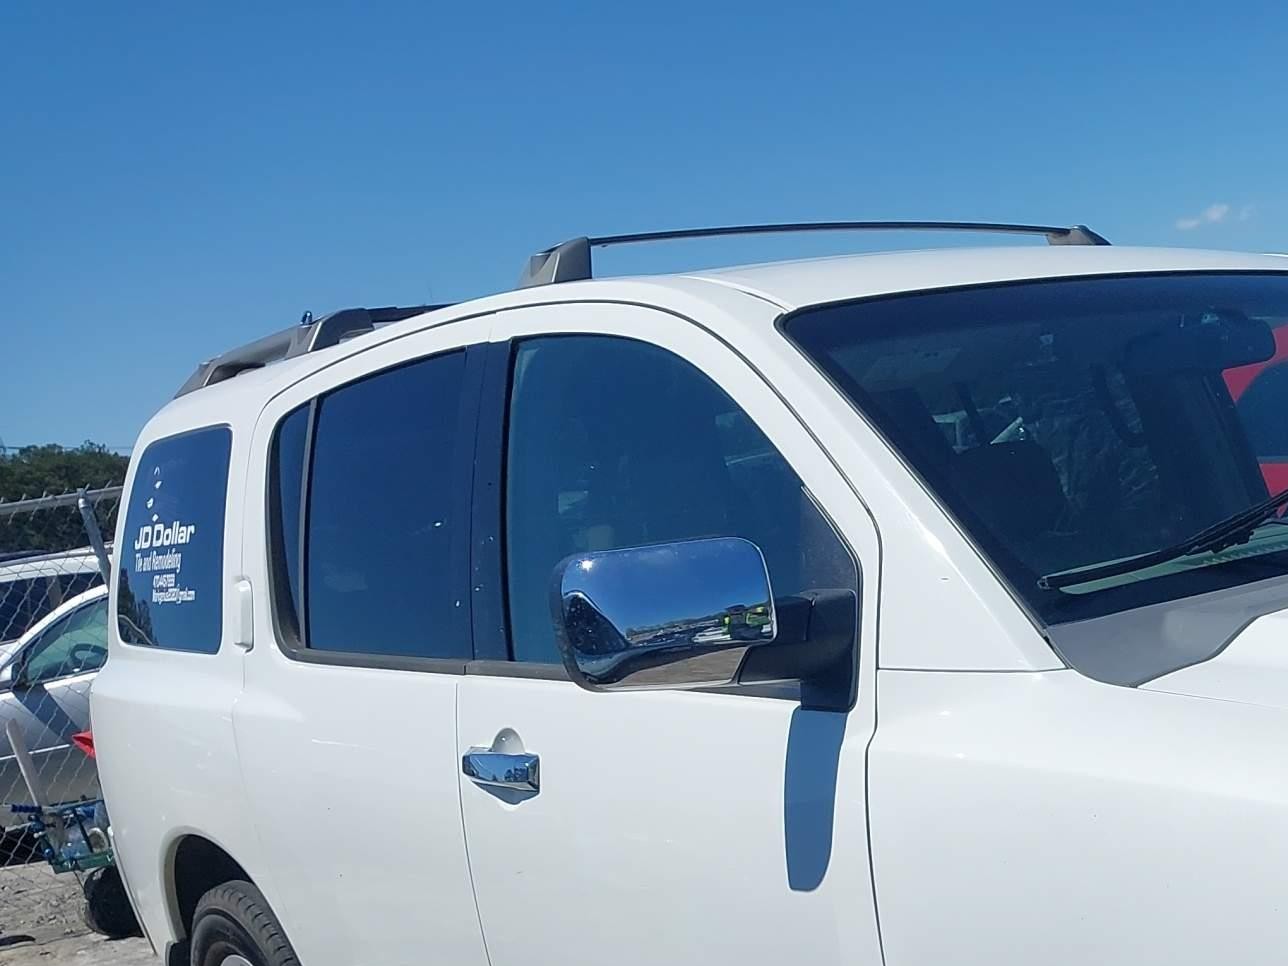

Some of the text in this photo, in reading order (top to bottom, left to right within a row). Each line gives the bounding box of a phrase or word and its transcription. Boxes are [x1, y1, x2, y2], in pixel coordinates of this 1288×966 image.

[135, 521, 195, 550] JD Dollar
[143, 551, 152, 572] and
[152, 548, 181, 574] Remodeling
